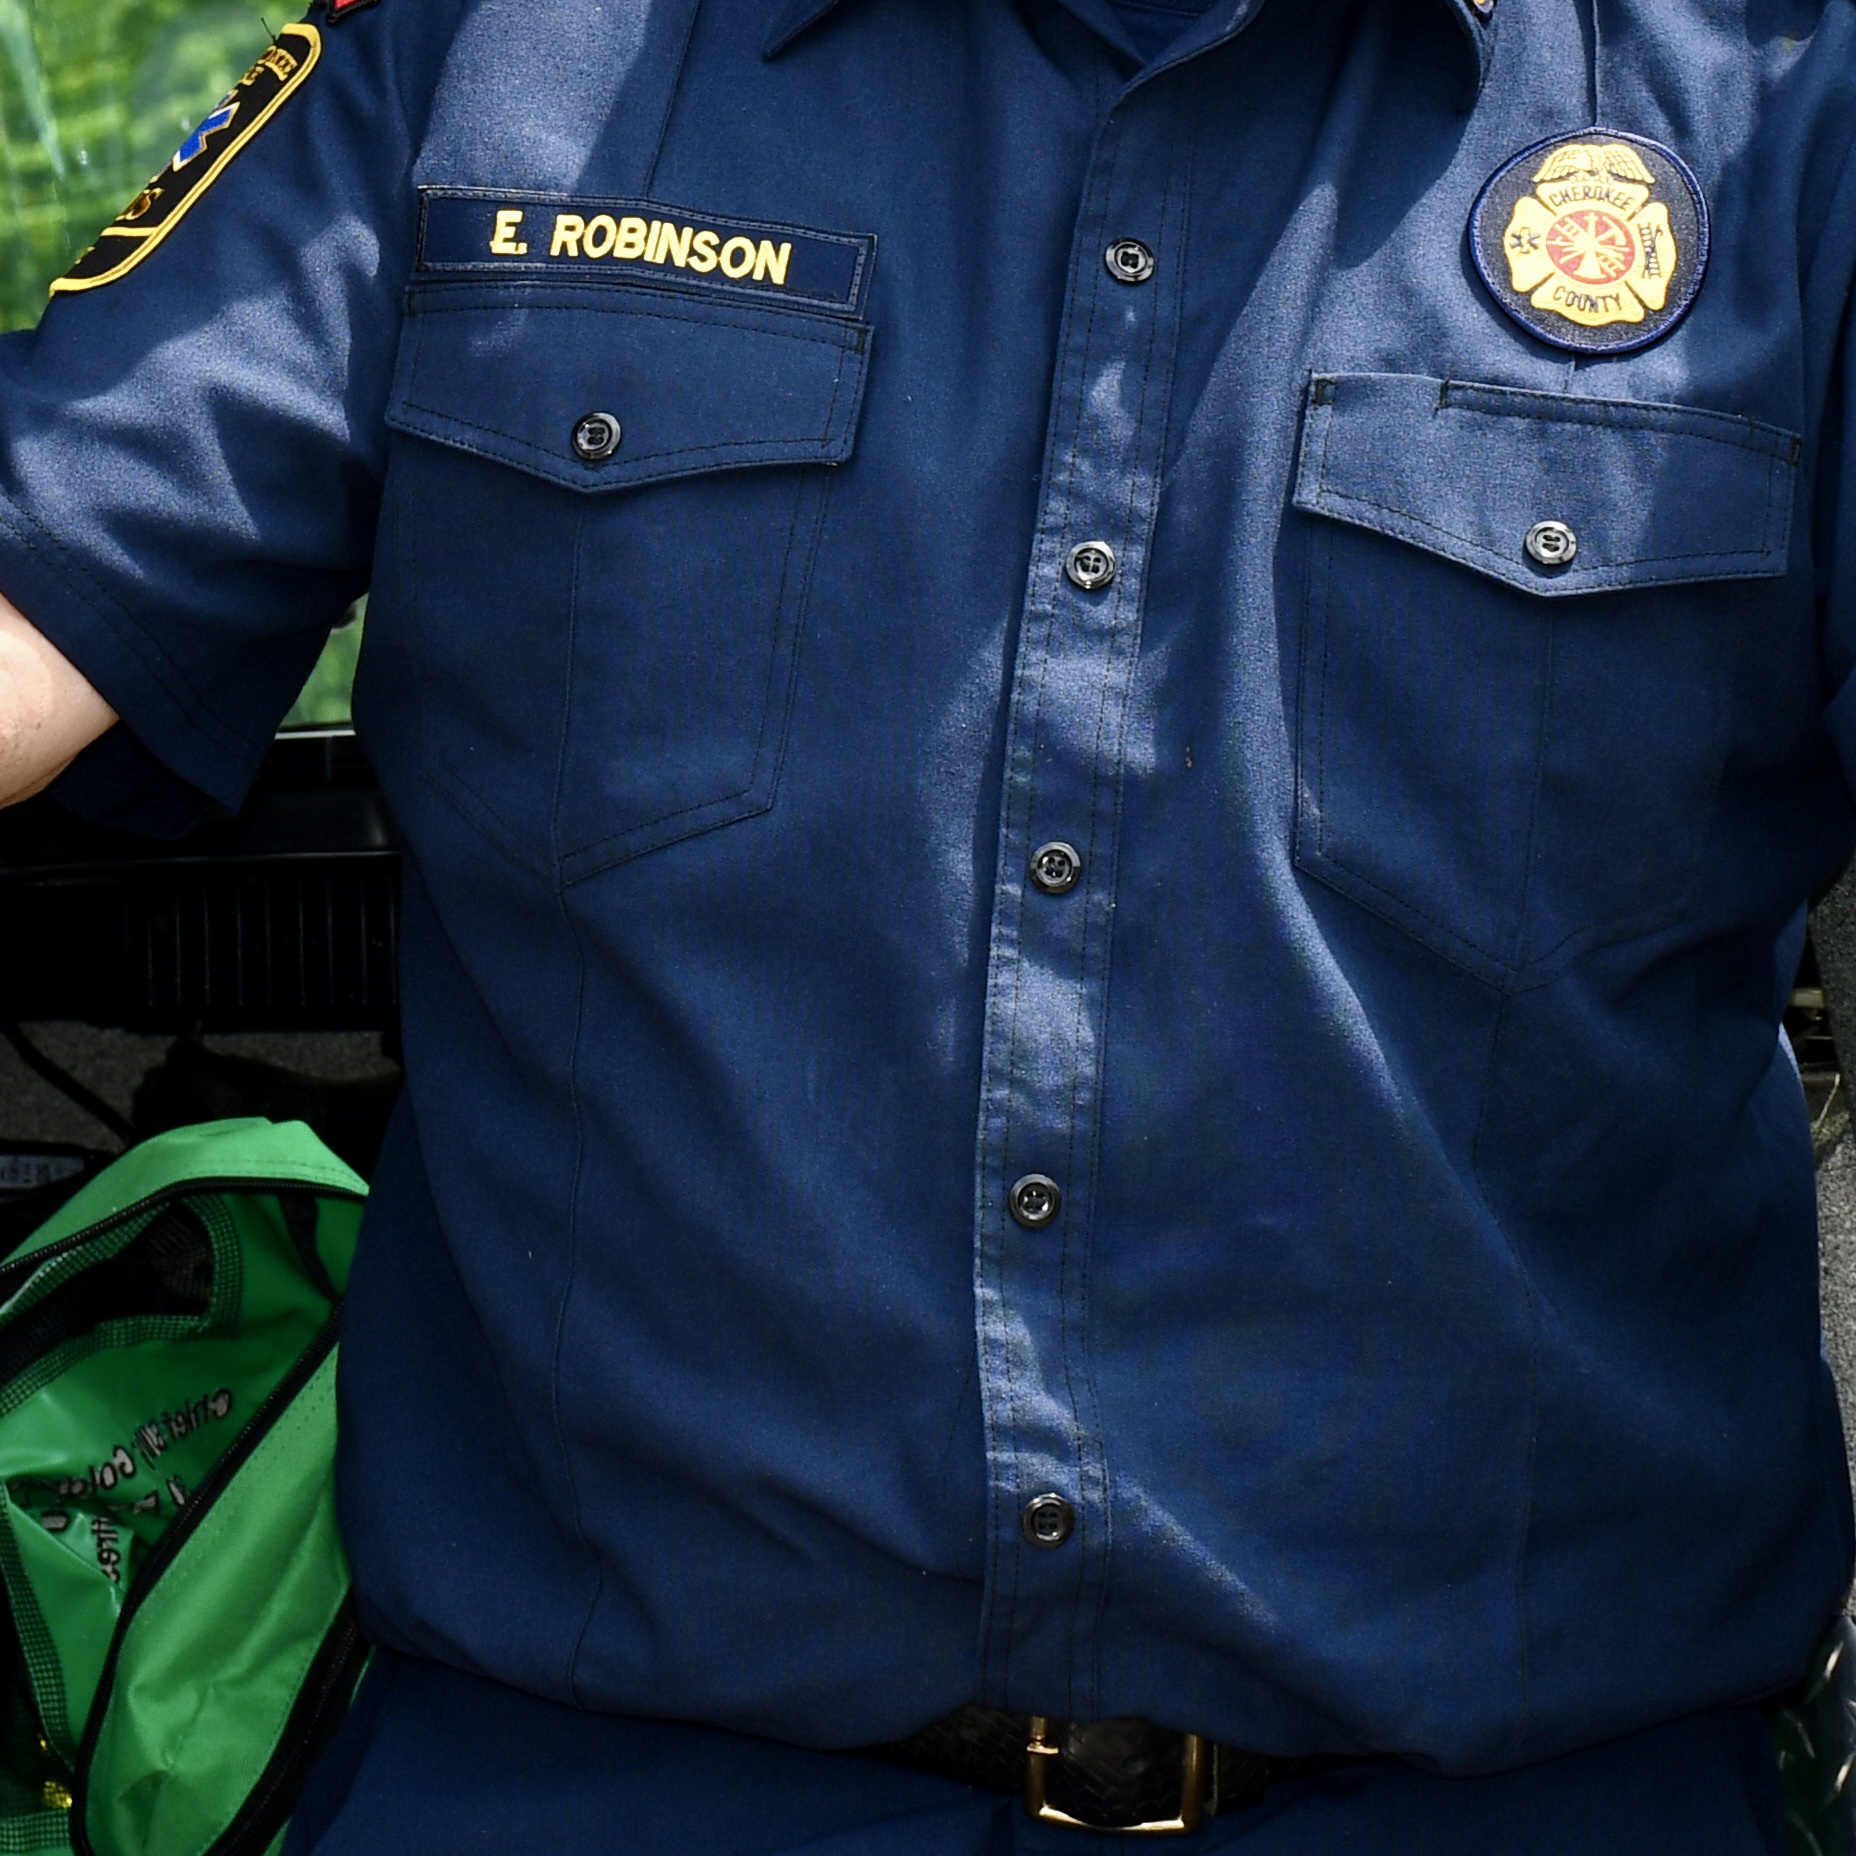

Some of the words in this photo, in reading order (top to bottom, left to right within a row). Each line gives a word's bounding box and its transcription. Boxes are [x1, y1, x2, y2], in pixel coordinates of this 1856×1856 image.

[1548, 185, 1637, 210] CHEROKEE
[490, 209, 528, 255] E.
[549, 212, 793, 285] ROBINSON
[1552, 285, 1621, 314] COUNTY
